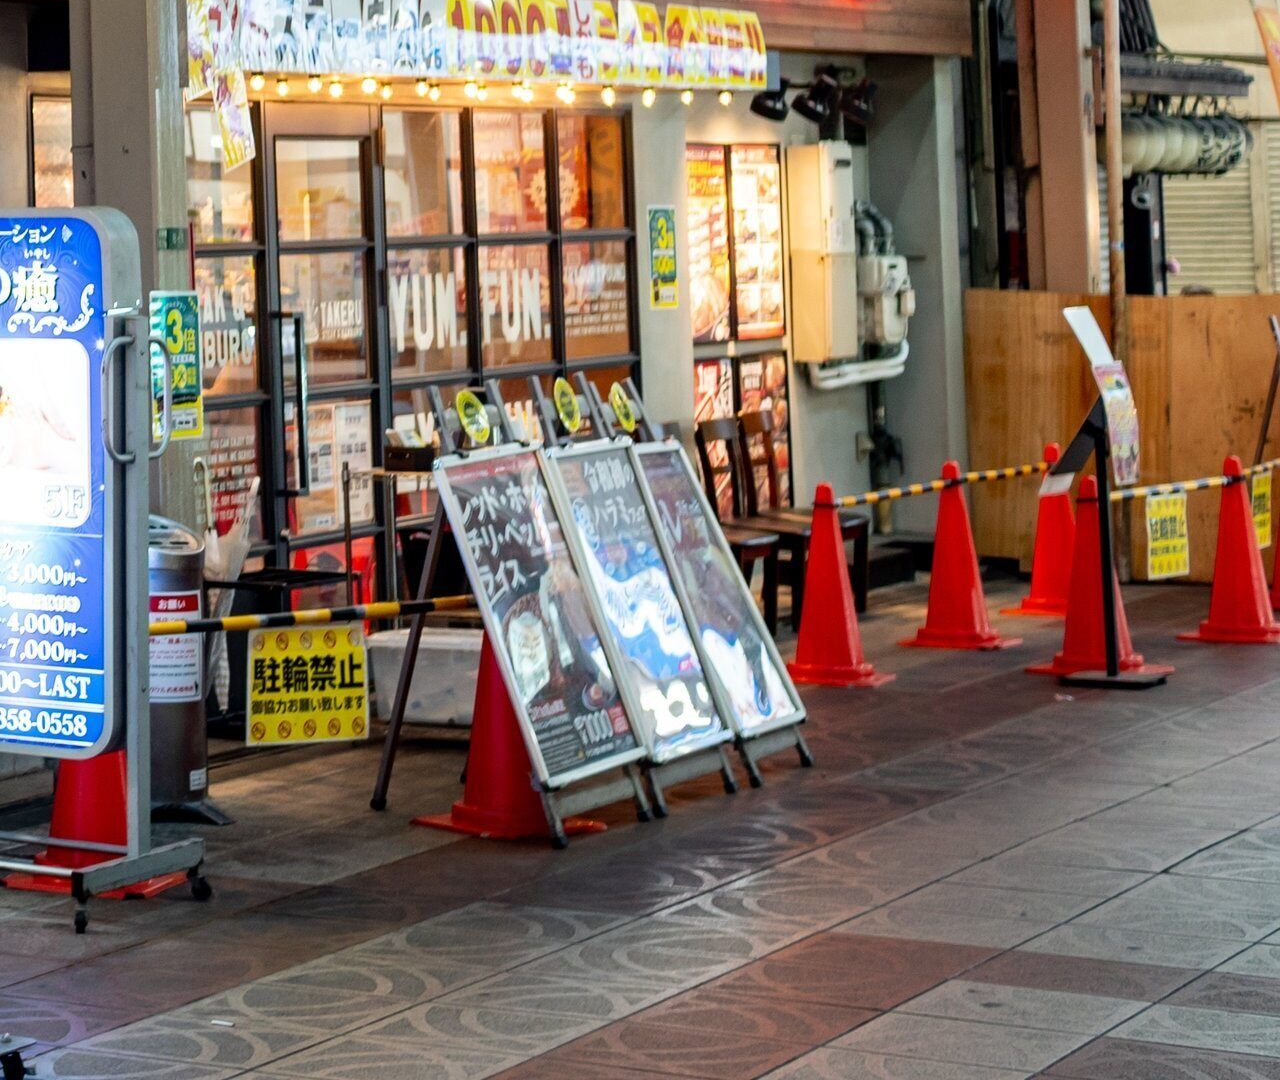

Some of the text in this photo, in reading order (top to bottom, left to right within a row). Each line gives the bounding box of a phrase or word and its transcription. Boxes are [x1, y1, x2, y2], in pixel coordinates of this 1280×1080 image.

[23, 249, 51, 262] いやし
[43, 483, 87, 522] 5F
[157, 598, 187, 611] お願い
[252, 653, 365, 695] 駐輪禁止
[251, 694, 366, 716] 御協力お願い致します
